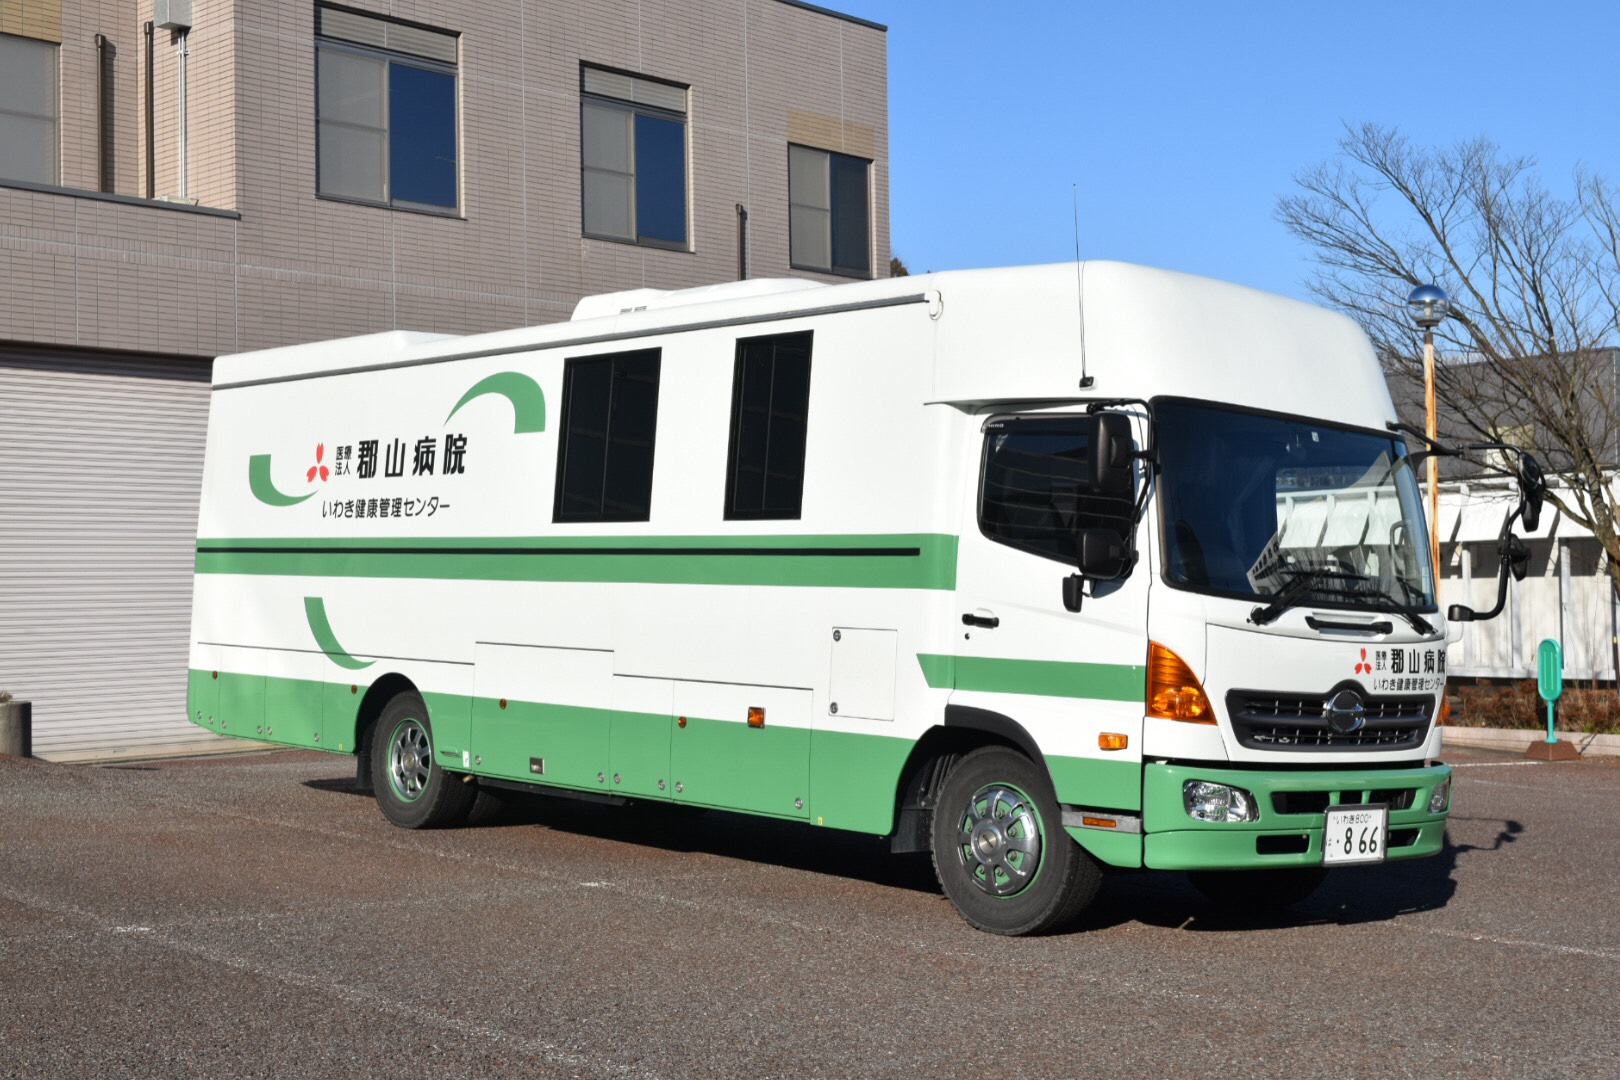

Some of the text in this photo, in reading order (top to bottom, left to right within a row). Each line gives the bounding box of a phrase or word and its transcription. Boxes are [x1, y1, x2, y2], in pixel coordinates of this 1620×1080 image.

[335, 445, 352, 460] 医療
[356, 433, 468, 479] 郡山病院
[334, 461, 351, 476] 法人
[322, 496, 450, 519] いわき健康管理センター
[1373, 677, 1444, 691] いわき健康管理センター
